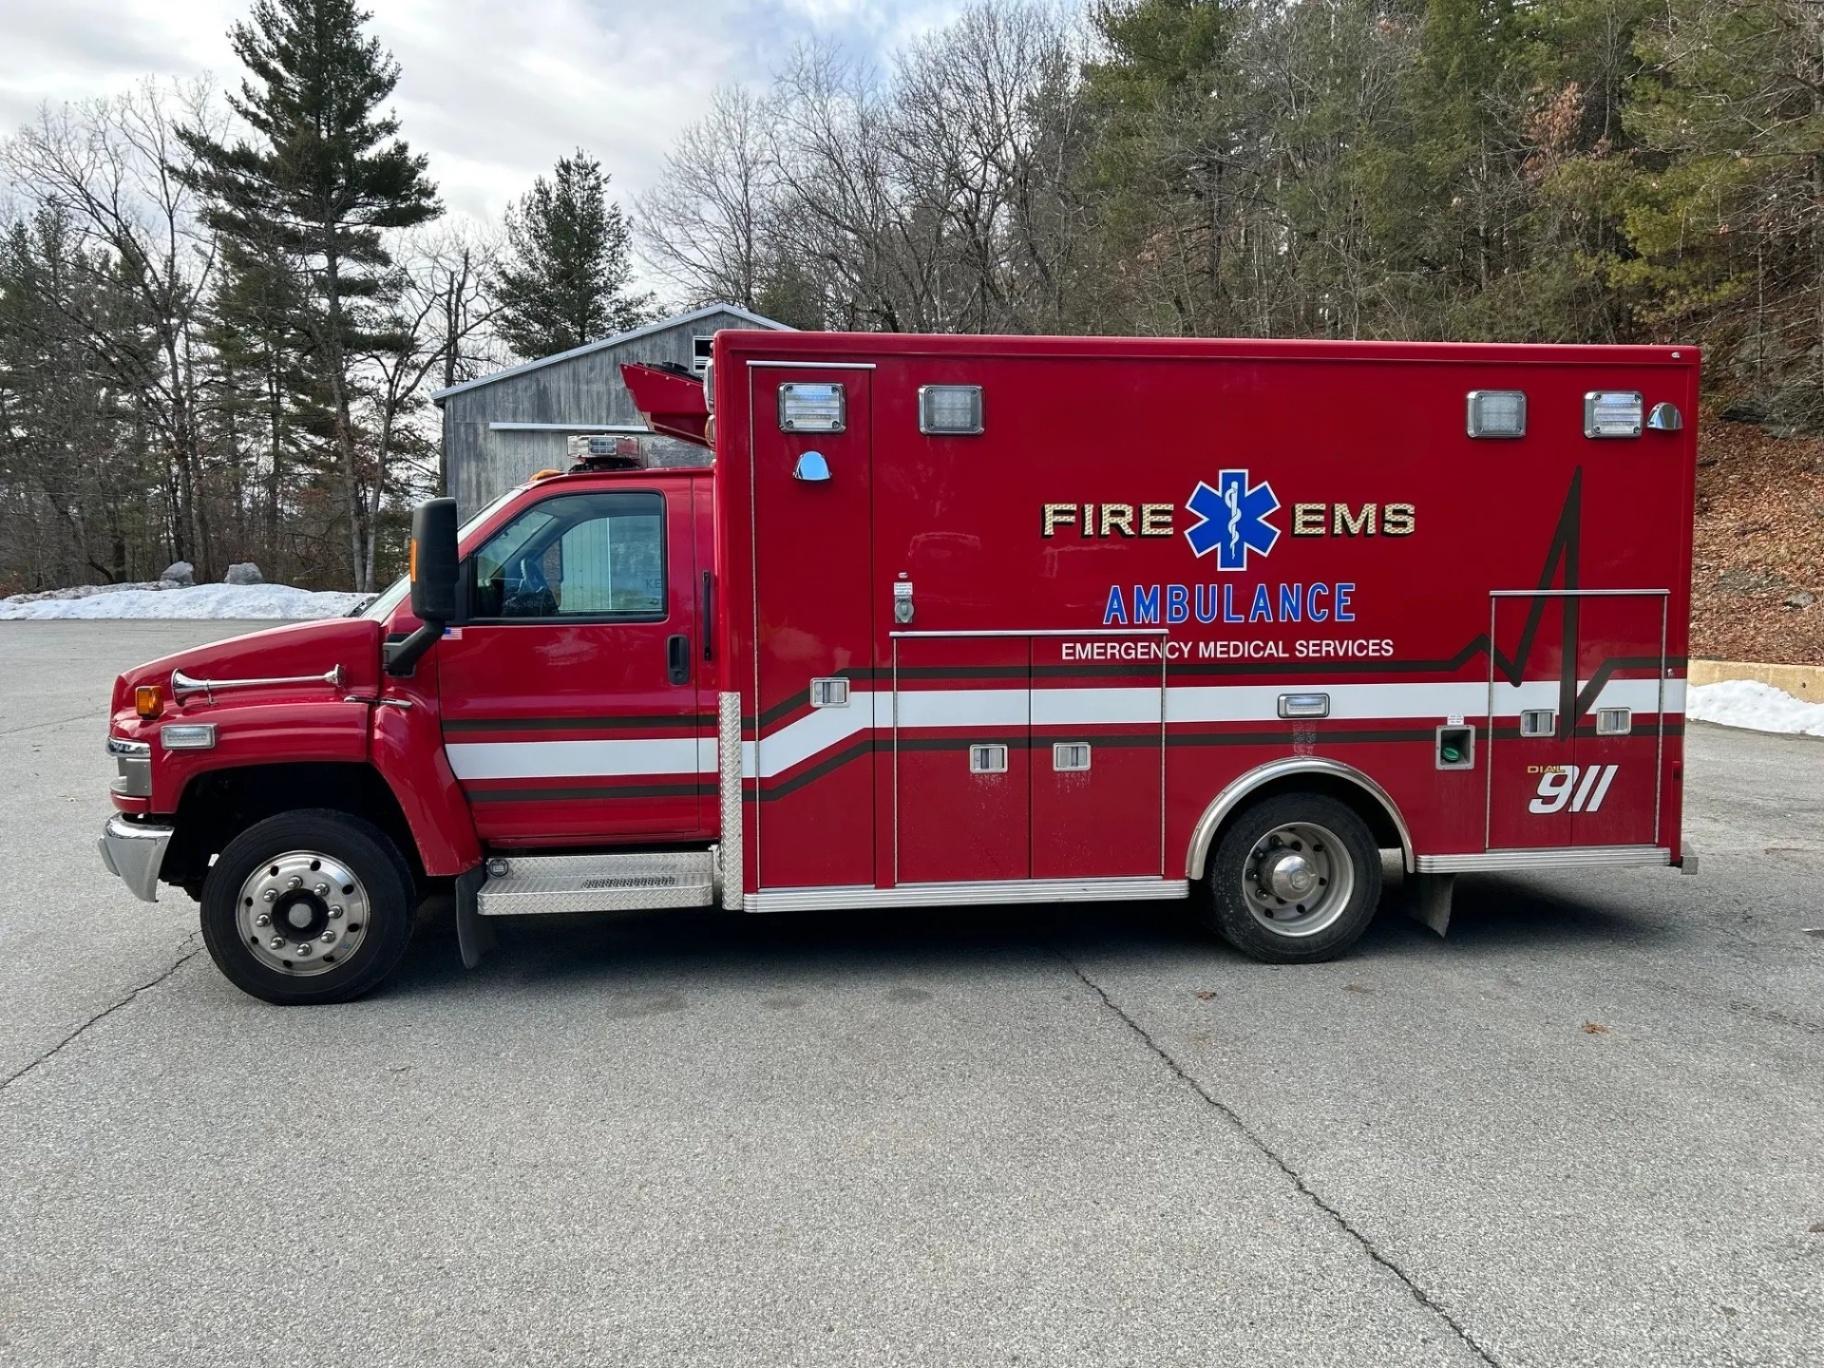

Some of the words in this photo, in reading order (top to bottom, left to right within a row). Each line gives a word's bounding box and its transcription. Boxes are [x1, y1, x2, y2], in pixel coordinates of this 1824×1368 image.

[1041, 503, 1174, 538] FIRE
[1290, 503, 1415, 538] EMS
[1102, 582, 1356, 625] AMBULANCE
[1061, 641, 1193, 660] EMERGENCY
[1198, 640, 1290, 659] MEDICAL
[1294, 639, 1394, 658] SERVICES
[1527, 765, 1566, 774] DIAL
[1529, 765, 1618, 814] 911
